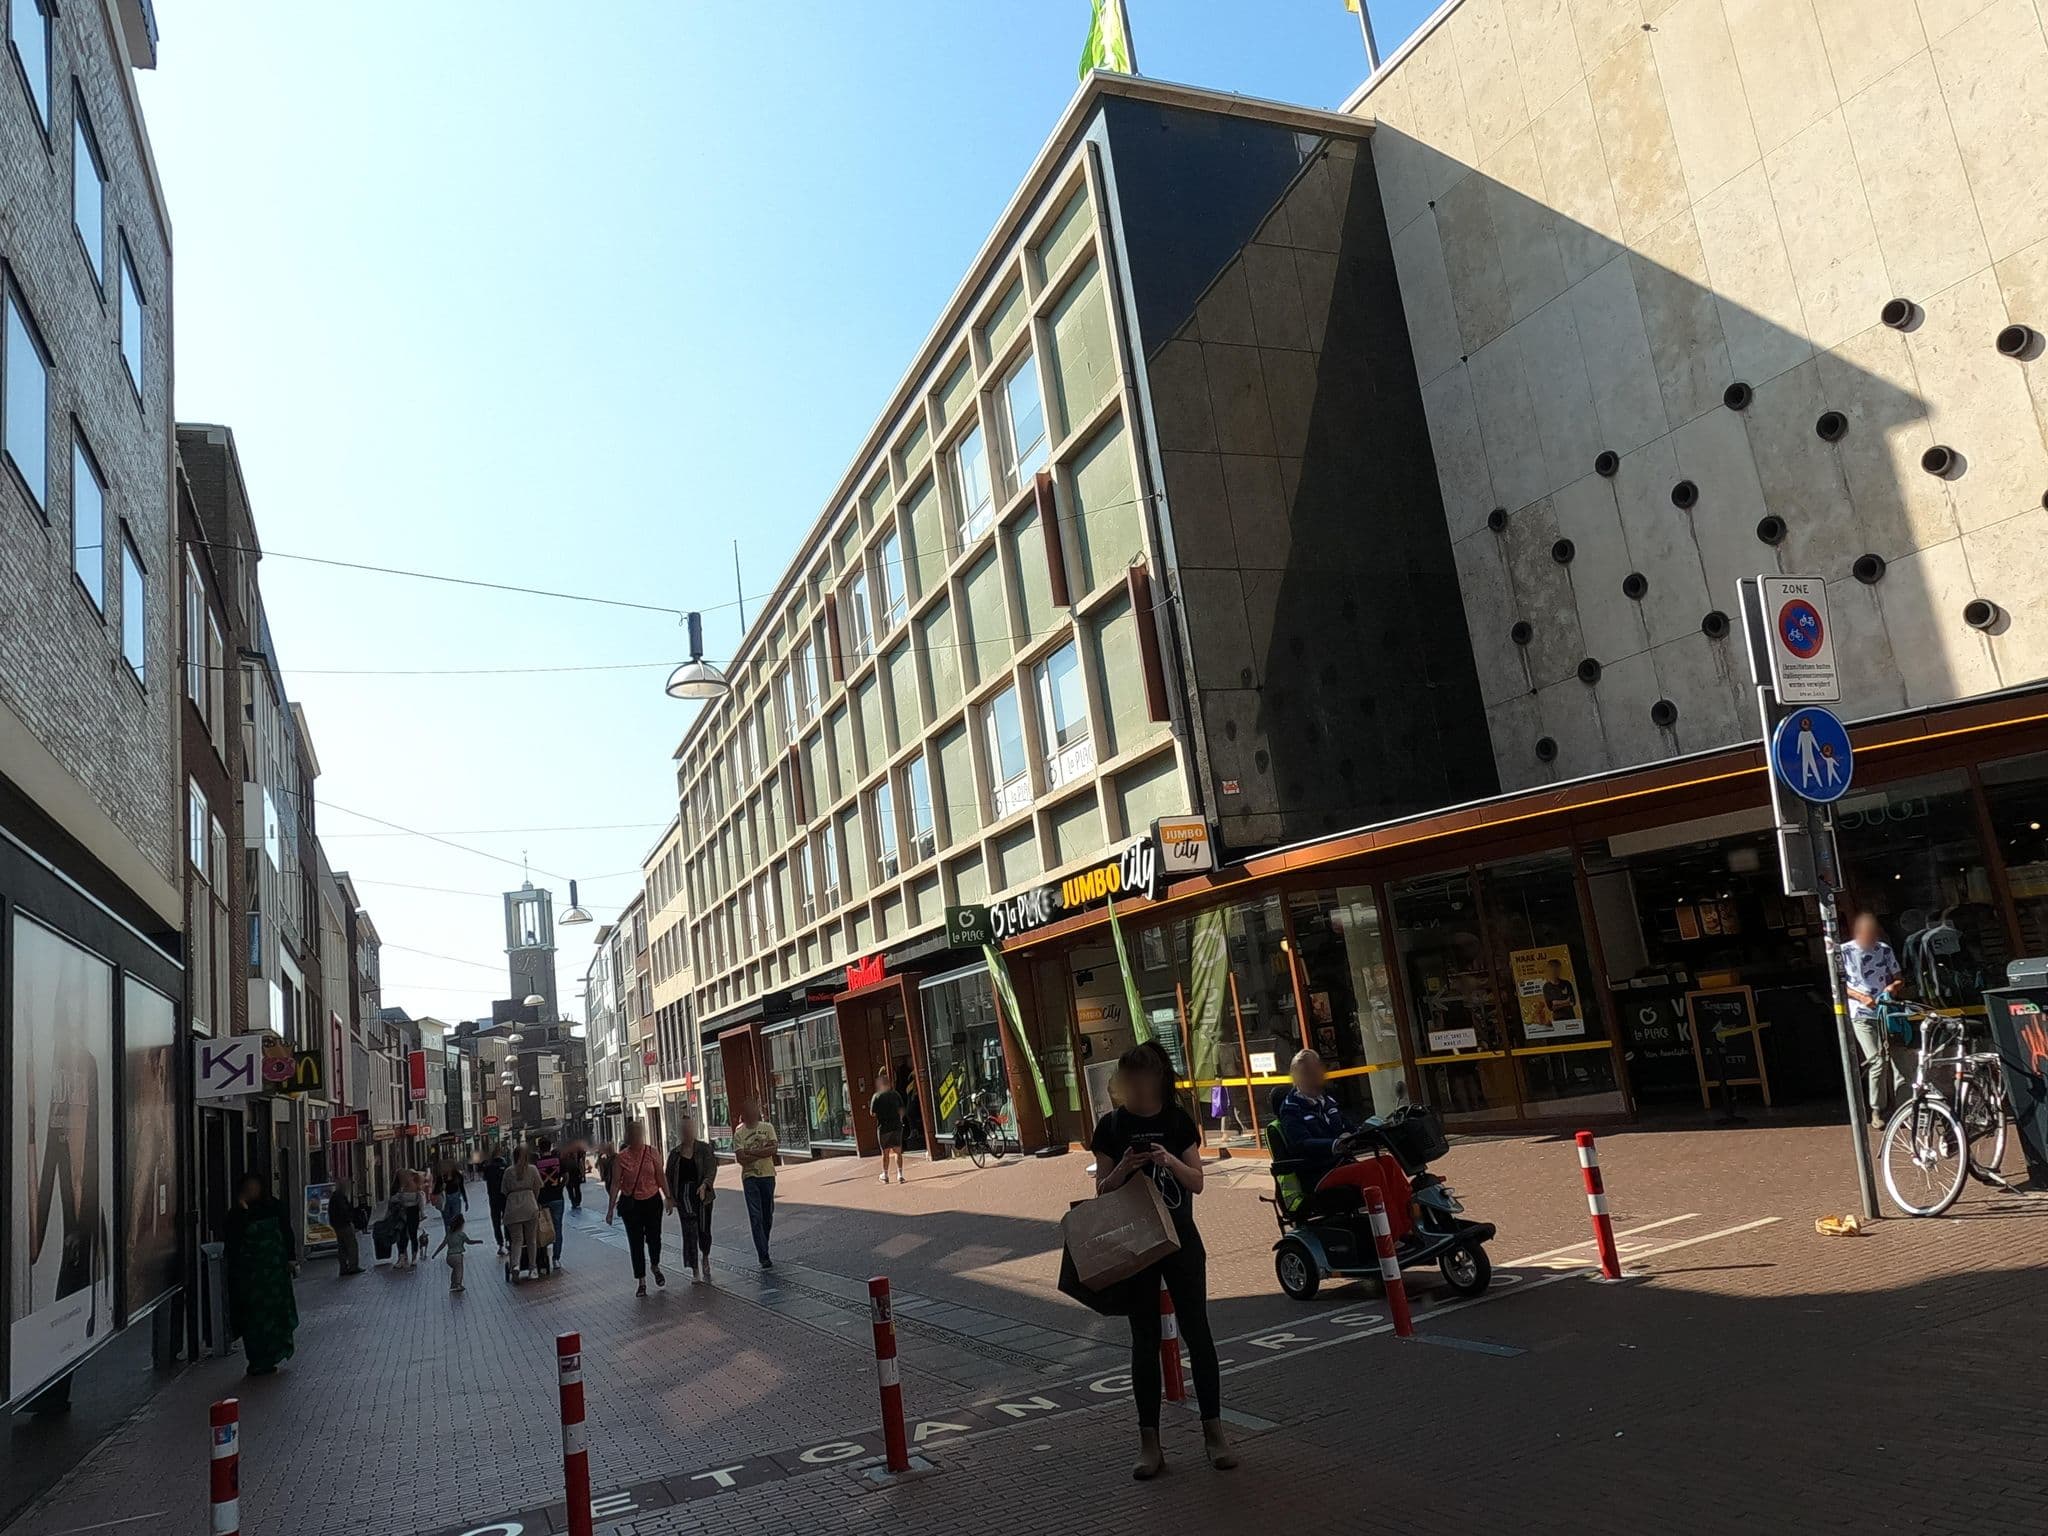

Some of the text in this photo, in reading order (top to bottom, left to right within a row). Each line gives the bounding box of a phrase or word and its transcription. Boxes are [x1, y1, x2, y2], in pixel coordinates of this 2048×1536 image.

[1782, 583, 1809, 594] ZONE
[1164, 826, 1204, 841] JUMBO
[1061, 863, 1121, 910] JUMBO
[962, 928, 985, 943] PLACE
[1644, 1026, 1670, 1040] PLACE
